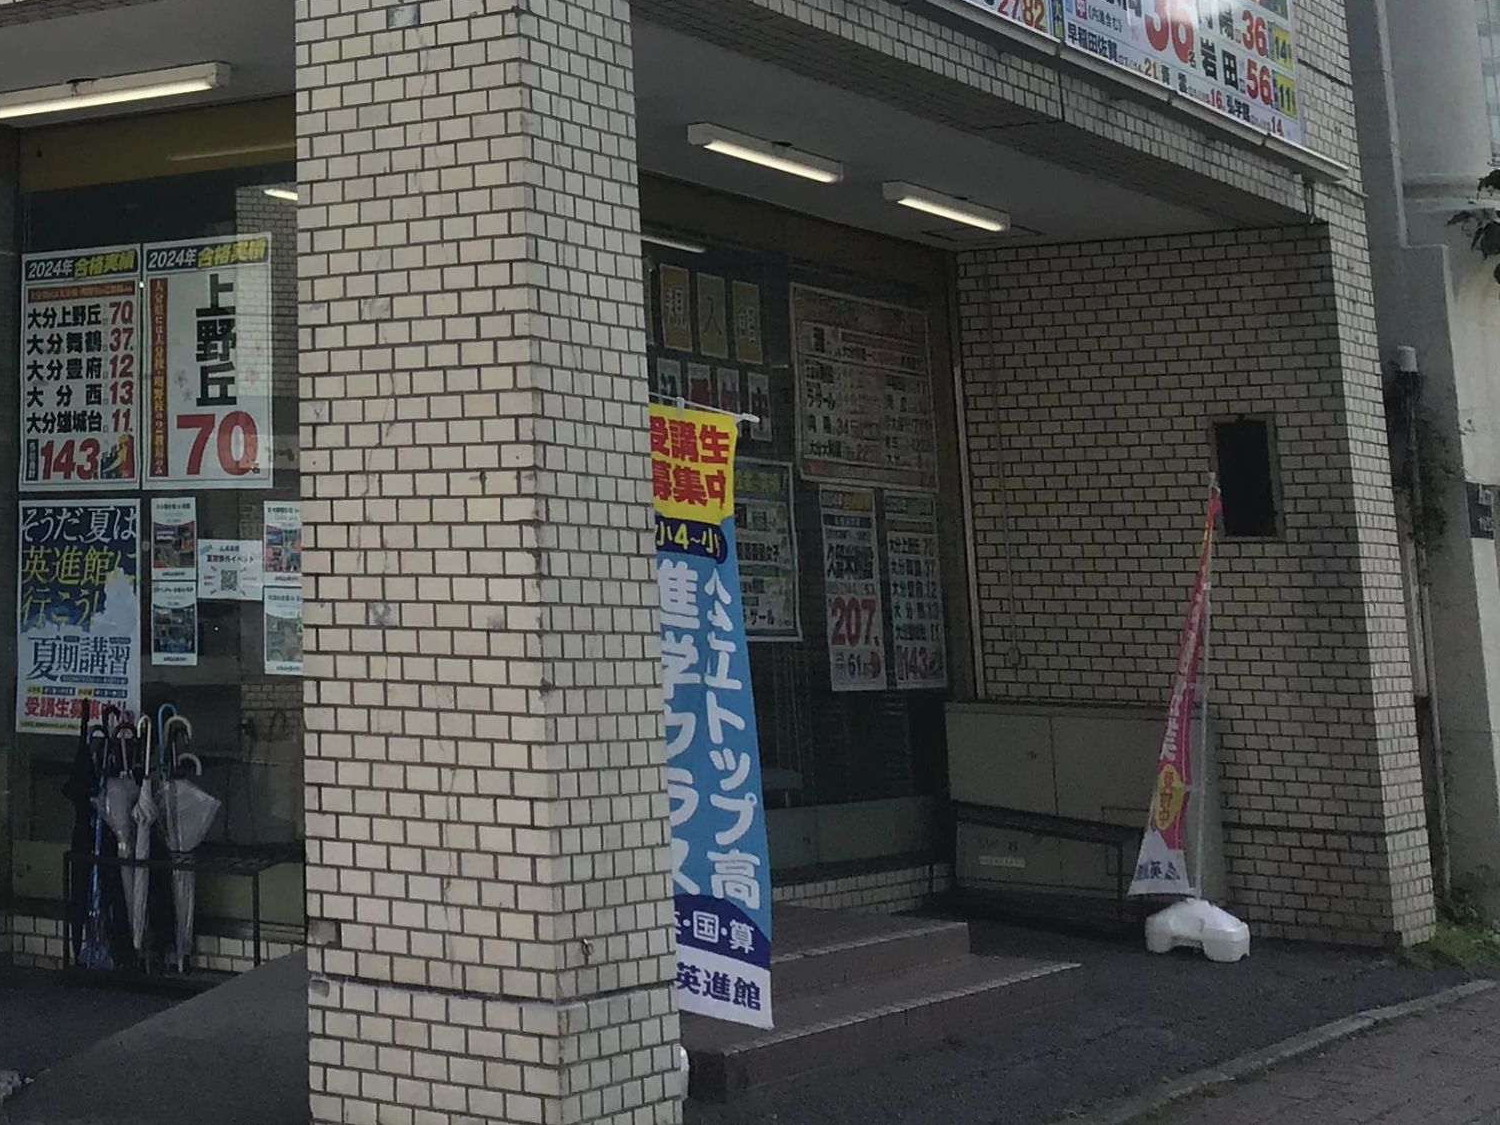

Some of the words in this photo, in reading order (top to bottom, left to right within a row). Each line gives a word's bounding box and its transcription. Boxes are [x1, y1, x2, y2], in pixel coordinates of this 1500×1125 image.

[1068, 22, 1118, 63] 早稲田佐賀
[1242, 10, 1267, 57] 36
[1200, 37, 1238, 93] 岩田
[1247, 58, 1272, 106] 56
[27, 304, 102, 329] 大分上野丘
[109, 301, 133, 325] 70
[27, 331, 102, 356] 大分舞鶴
[109, 328, 133, 352] 37
[196, 273, 237, 407] 上野丘
[27, 356, 102, 381] 大分豊府
[109, 354, 134, 378] 12
[27, 383, 102, 408] 大分西
[109, 380, 133, 405] 13
[27, 410, 102, 434] 大分雄城台
[112, 408, 133, 432] 11
[176, 410, 259, 476] 70
[650, 415, 731, 464] 受講生
[41, 437, 99, 481] 143
[21, 505, 137, 543] そうだ、夏は
[21, 545, 137, 587] 英進館に
[831, 597, 877, 648] 207
[26, 635, 130, 682] 夏期講習
[675, 962, 762, 1011] 英進館
